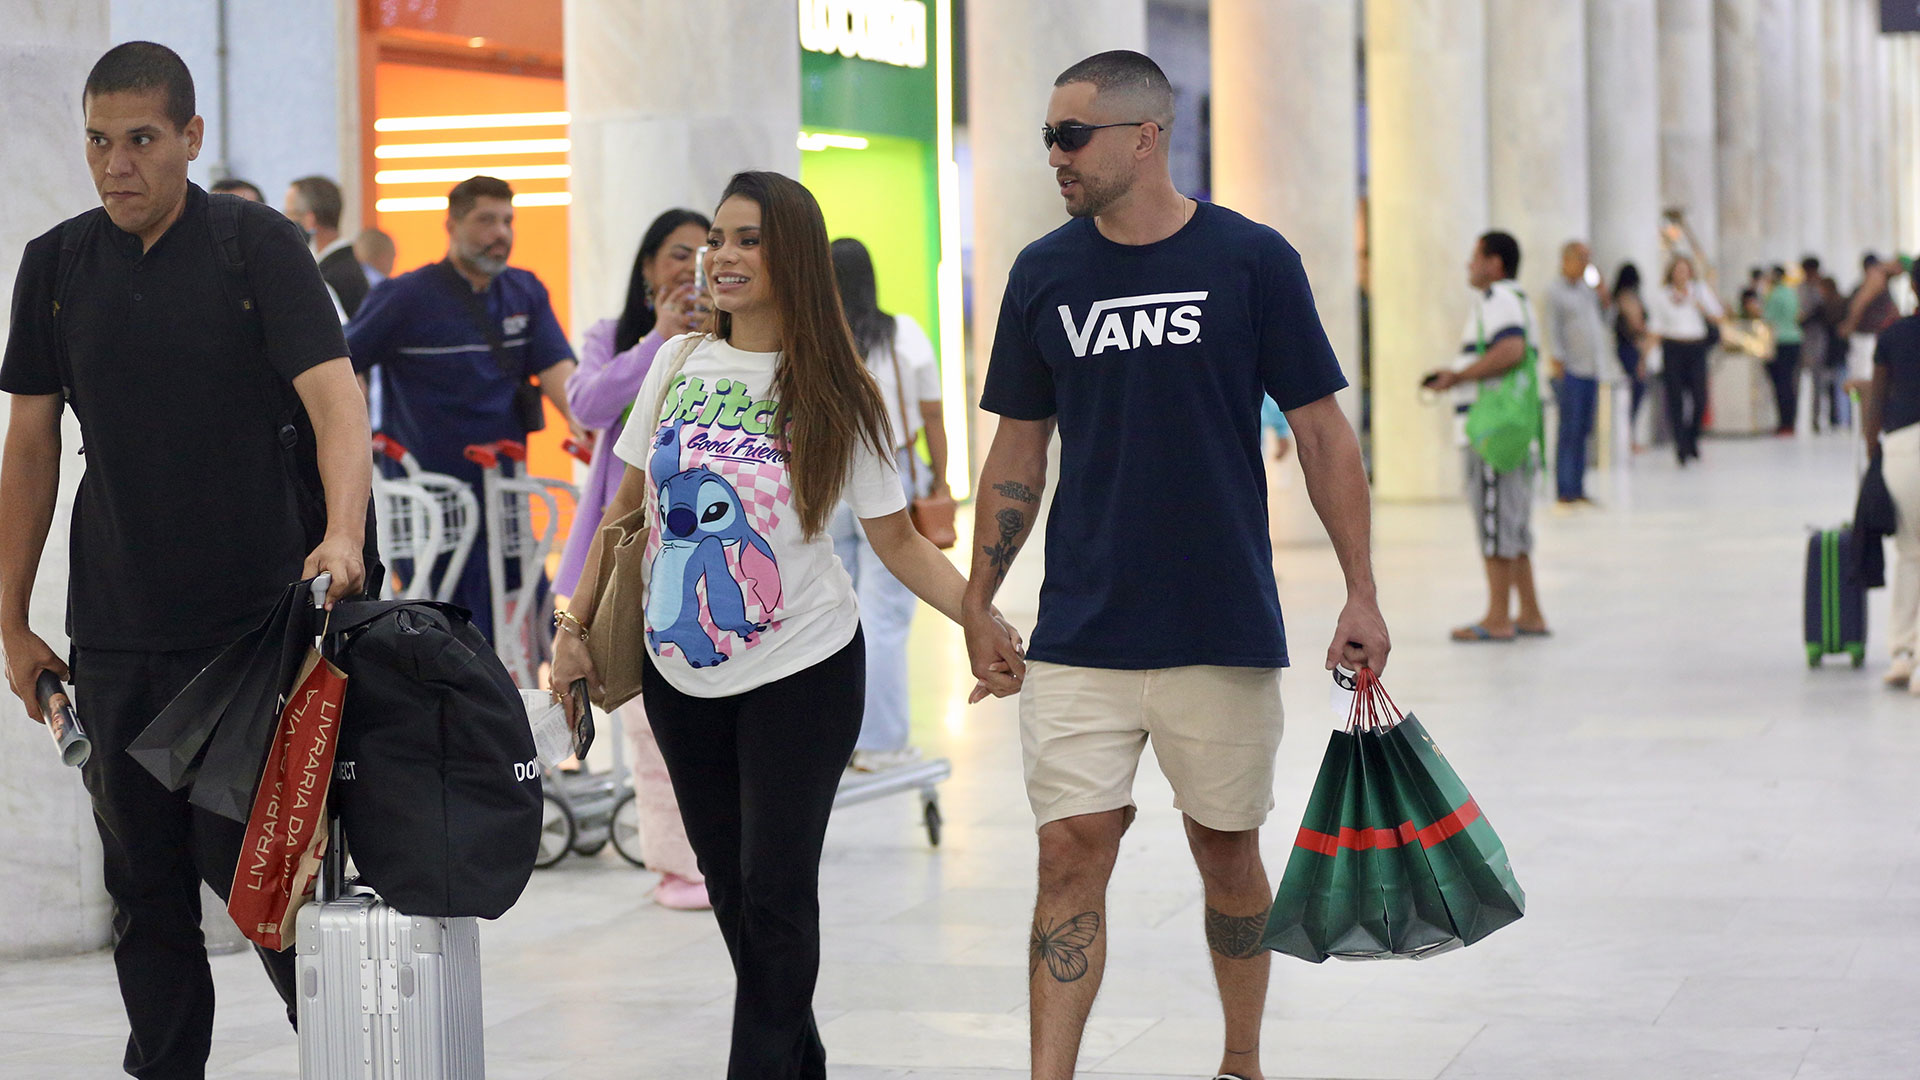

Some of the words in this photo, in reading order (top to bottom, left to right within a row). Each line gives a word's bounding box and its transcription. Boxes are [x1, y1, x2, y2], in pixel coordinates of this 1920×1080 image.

[1057, 291, 1209, 358] VANS
[659, 374, 791, 438] Stitc
[687, 432, 736, 455] Good
[285, 689, 319, 735] VILA
[293, 700, 337, 809] LIVRARIA
[286, 815, 304, 847] DA
